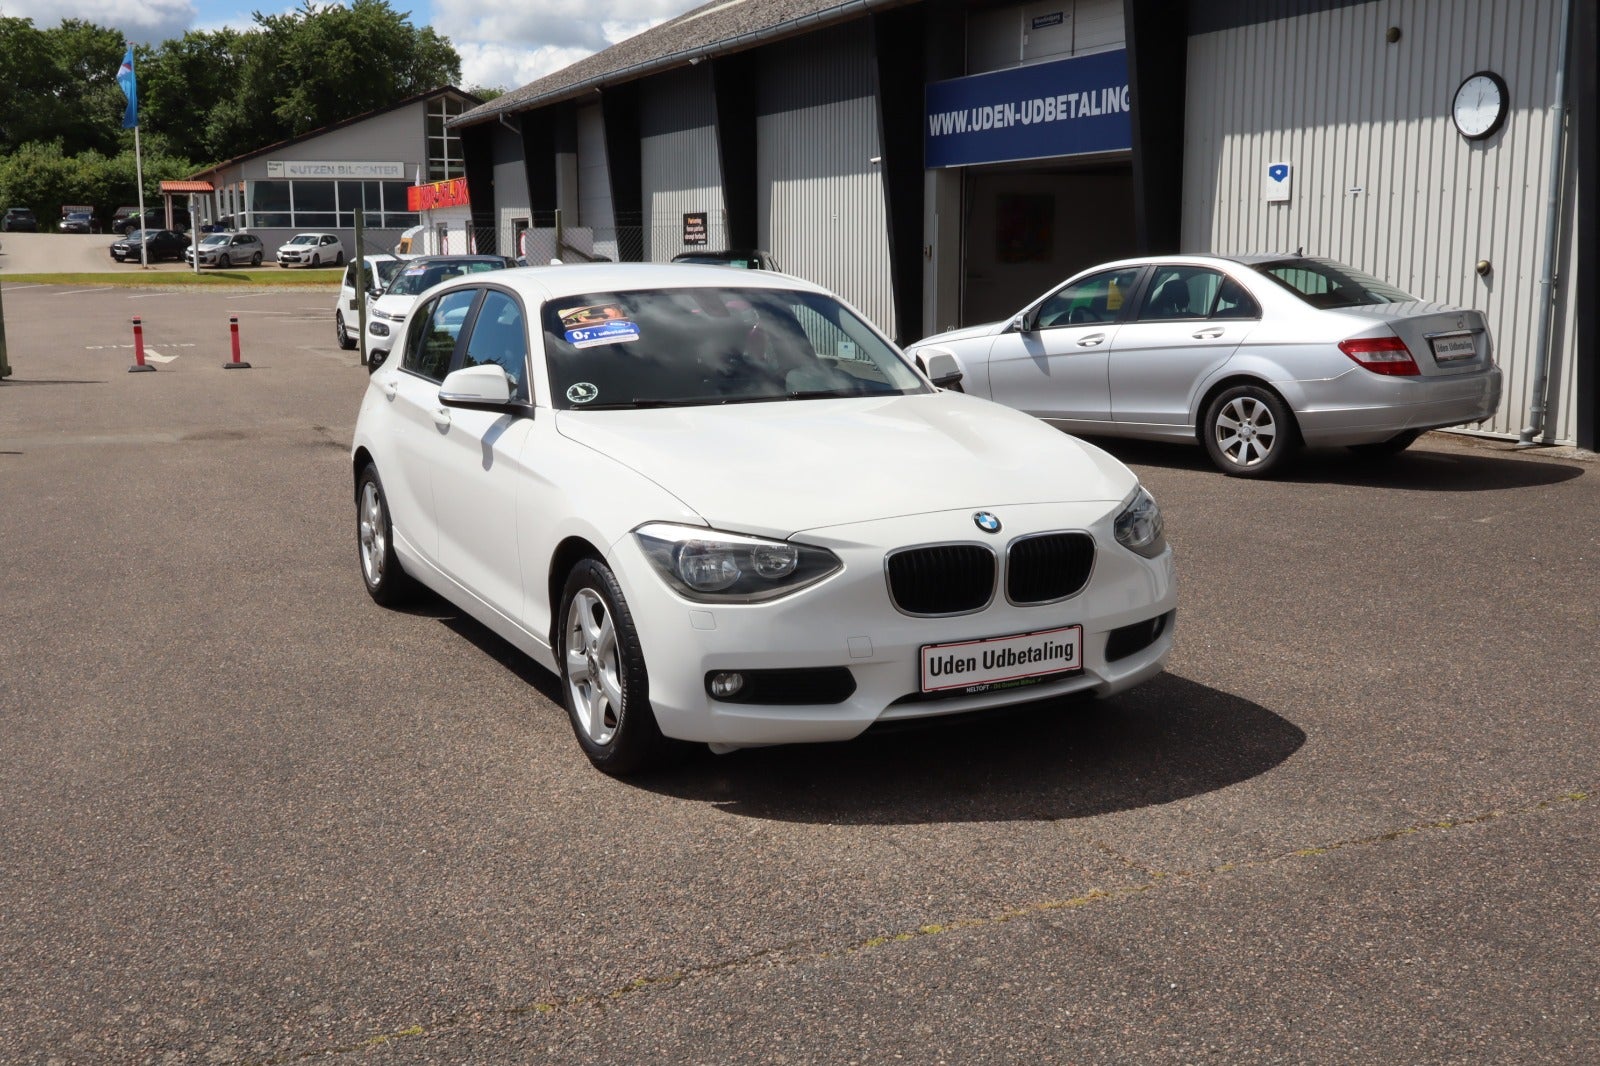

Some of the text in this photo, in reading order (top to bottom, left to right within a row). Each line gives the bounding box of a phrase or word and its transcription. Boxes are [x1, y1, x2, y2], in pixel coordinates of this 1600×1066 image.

[930, 641, 1074, 677] Uden Udbetaling
[966, 684, 989, 693] HELTOFT
